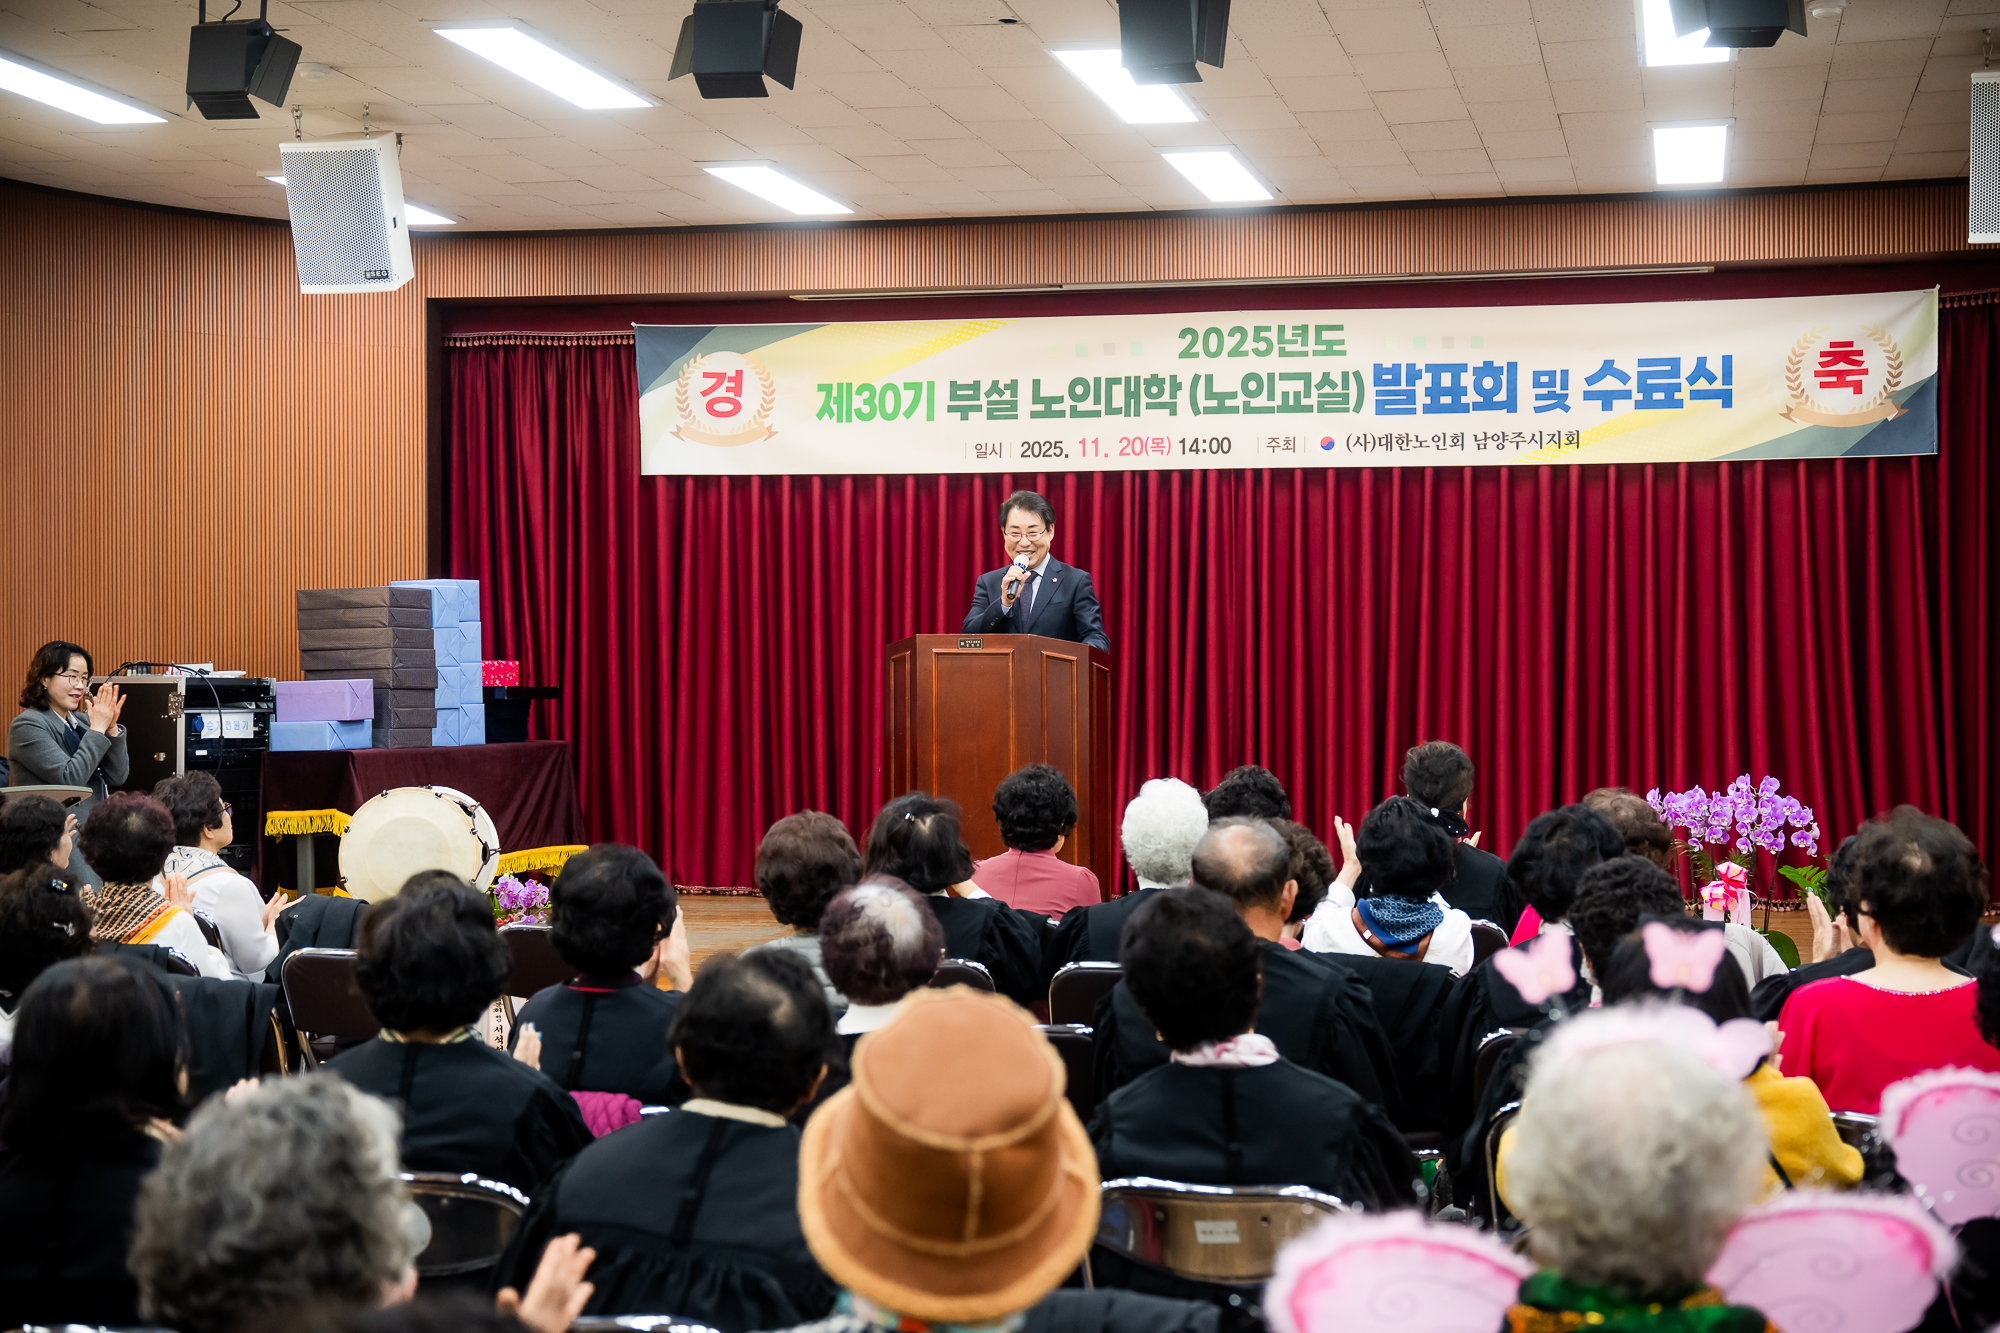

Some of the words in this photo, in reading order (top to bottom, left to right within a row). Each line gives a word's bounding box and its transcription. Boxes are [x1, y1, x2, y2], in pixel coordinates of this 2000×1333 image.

[1178, 324, 1347, 359] 2025년도
[1813, 340, 1869, 395] 축
[700, 369, 743, 418] 경
[815, 381, 935, 423] 제30기
[947, 379, 1018, 421] 부설
[1030, 374, 1182, 419] 노인대학
[1189, 370, 1365, 417] (노인교실)
[1373, 360, 1518, 415] 발표회
[1532, 369, 1571, 413] 및
[1583, 355, 1733, 411] 수료식
[975, 442, 1002, 459] 일시
[1020, 441, 1069, 459] 2025.
[1078, 437, 1109, 458] 11.
[1118, 436, 1171, 457] 20(목)
[1179, 437, 1232, 455] 14:00
[1266, 436, 1296, 453] 주최
[1346, 432, 1465, 453] (사)대한노인회
[1473, 430, 1580, 451] 남양주시지회
